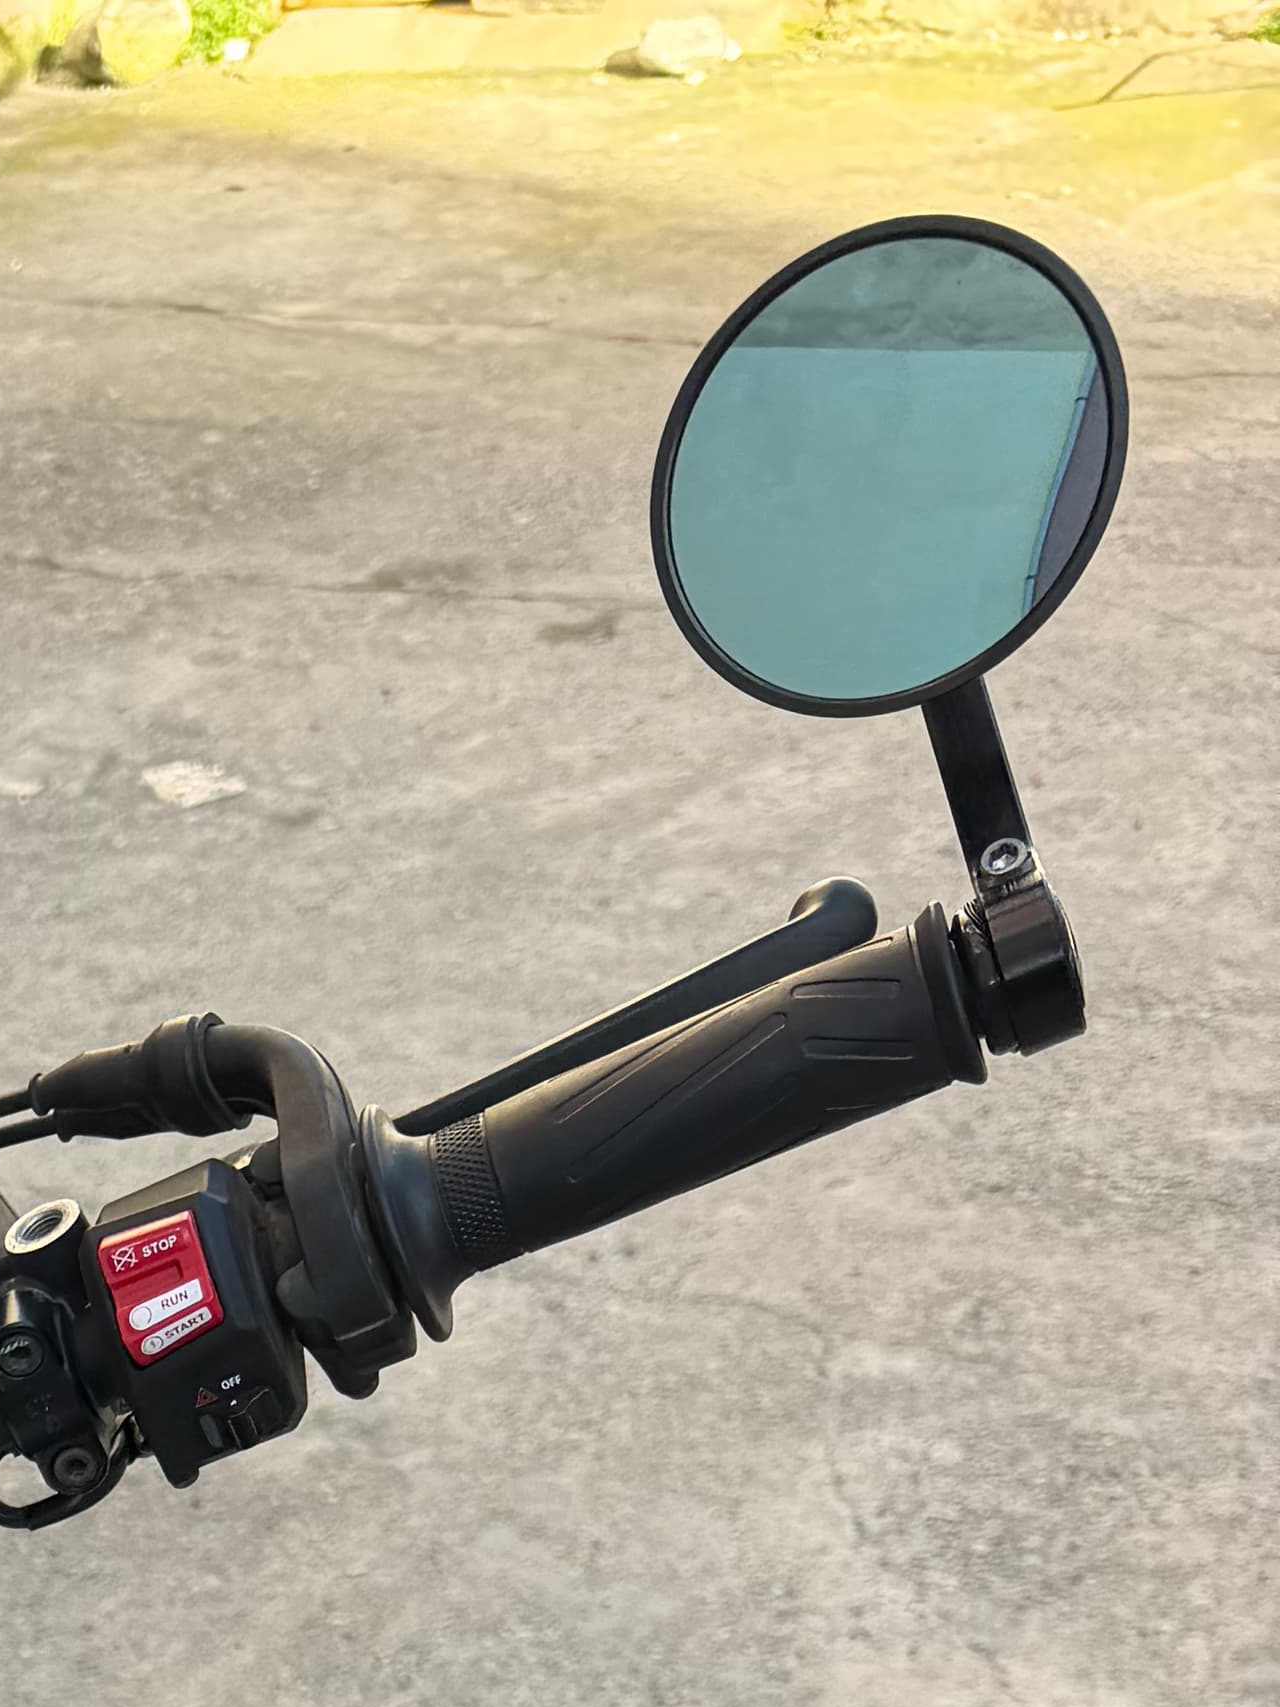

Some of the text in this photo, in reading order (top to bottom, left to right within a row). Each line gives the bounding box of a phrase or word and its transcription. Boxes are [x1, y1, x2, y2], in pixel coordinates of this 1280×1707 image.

[142, 1235, 177, 1258] STOP
[160, 1289, 189, 1311] RUN
[164, 1312, 205, 1340] START
[220, 1374, 242, 1390] OFF
